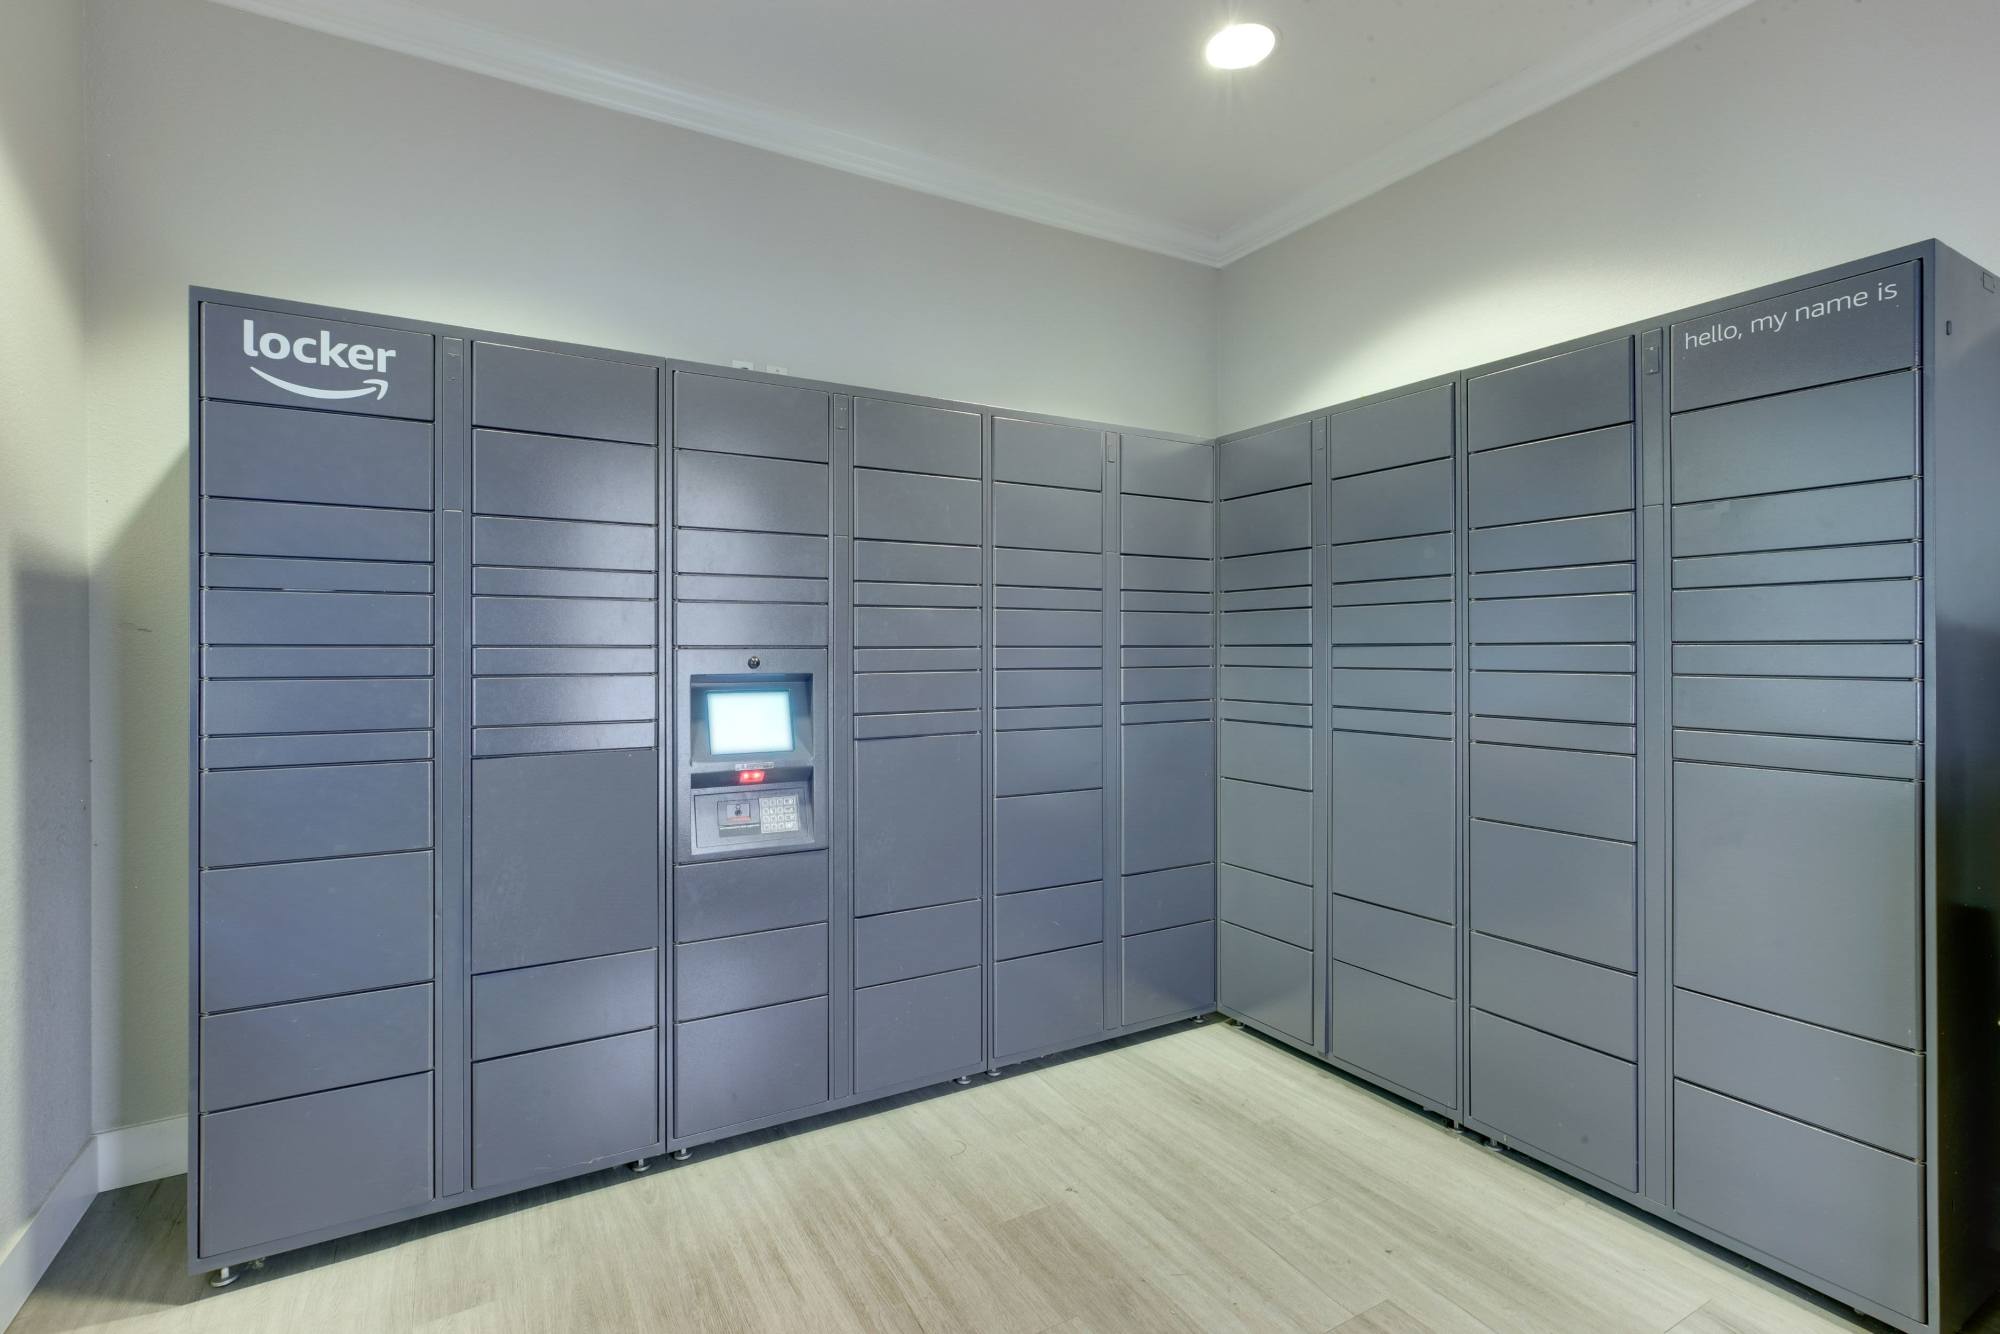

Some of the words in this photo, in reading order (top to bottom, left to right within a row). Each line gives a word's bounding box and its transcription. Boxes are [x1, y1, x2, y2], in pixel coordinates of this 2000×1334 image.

[243, 319, 397, 373] locker
[1685, 325, 1743, 350] hello,
[1750, 311, 1788, 333] my
[1795, 291, 1869, 322] name
[1877, 282, 1899, 302] is
